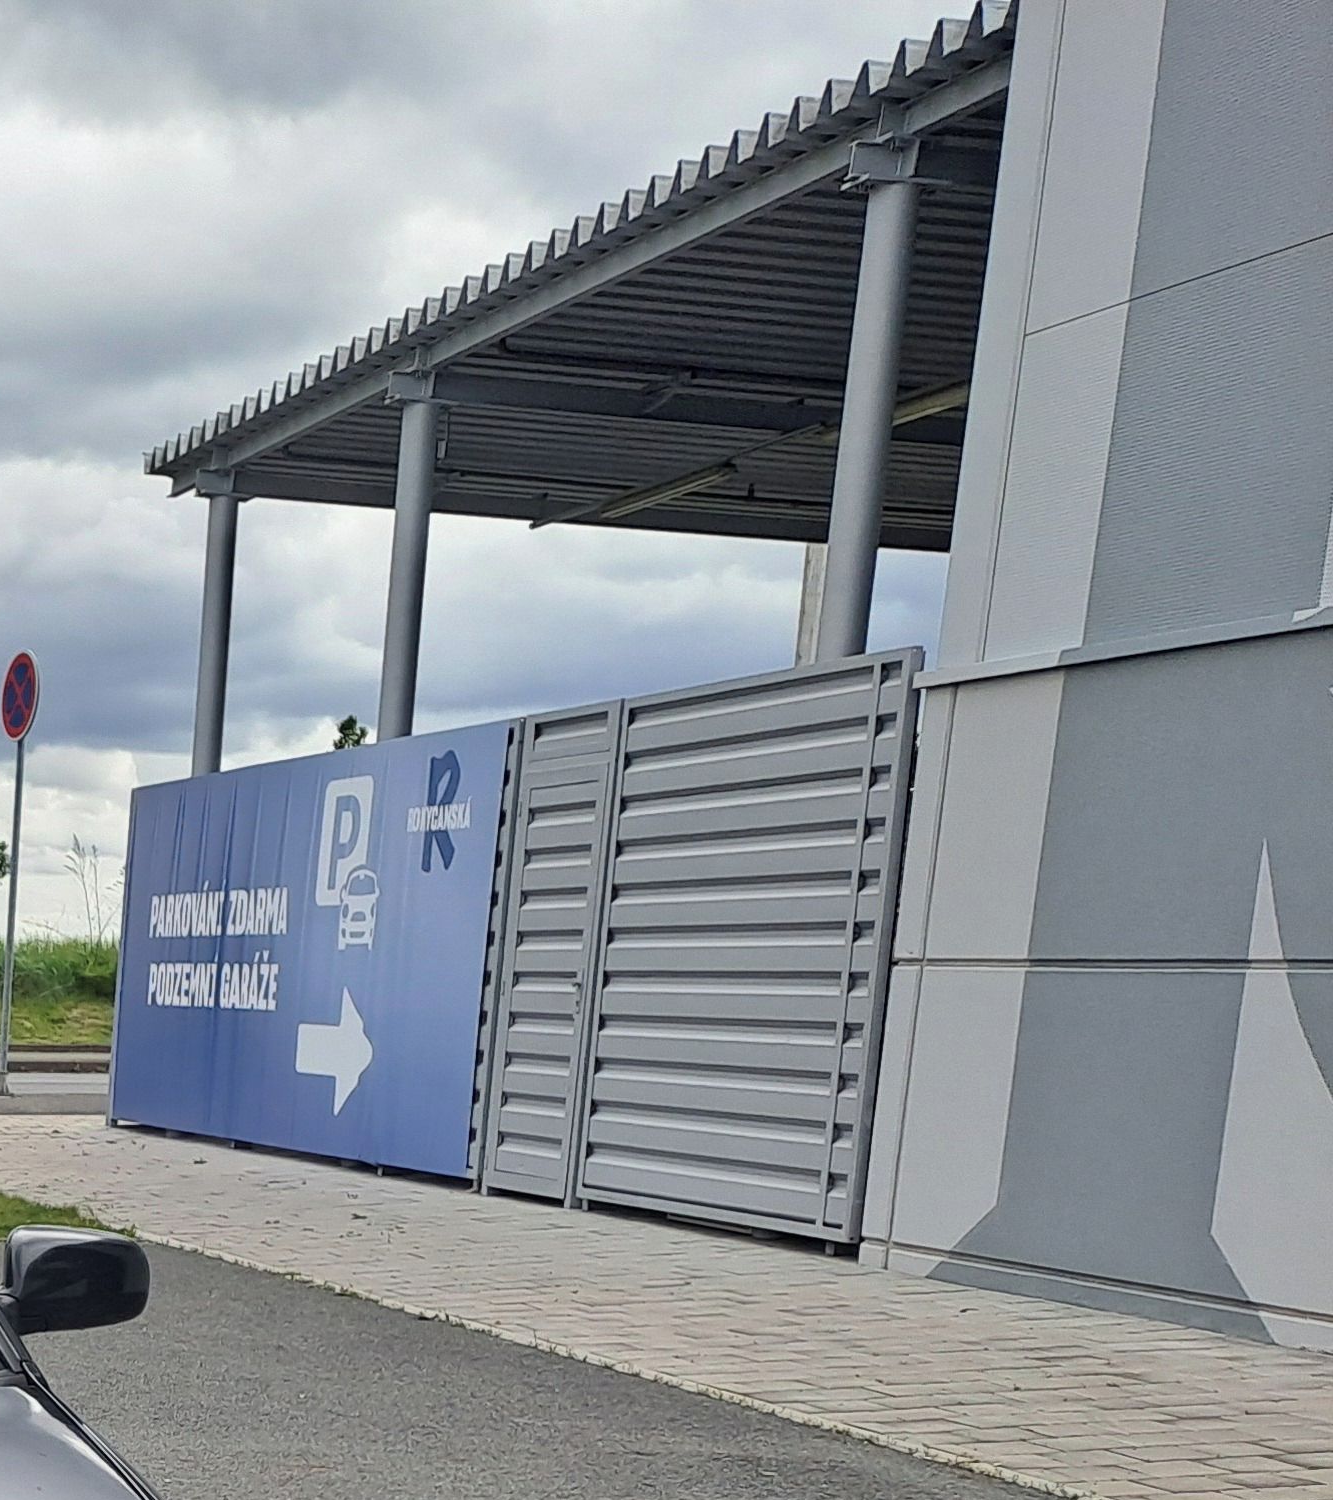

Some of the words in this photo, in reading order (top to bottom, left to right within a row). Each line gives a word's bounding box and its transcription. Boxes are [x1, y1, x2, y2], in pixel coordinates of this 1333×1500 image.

[327, 794, 361, 891] P
[149, 880, 225, 938] PARKOVÁNÍ
[226, 887, 288, 937] ZDARMA
[147, 951, 219, 1008] PODZEMNÍ
[219, 950, 279, 1011] GARÁŽE
